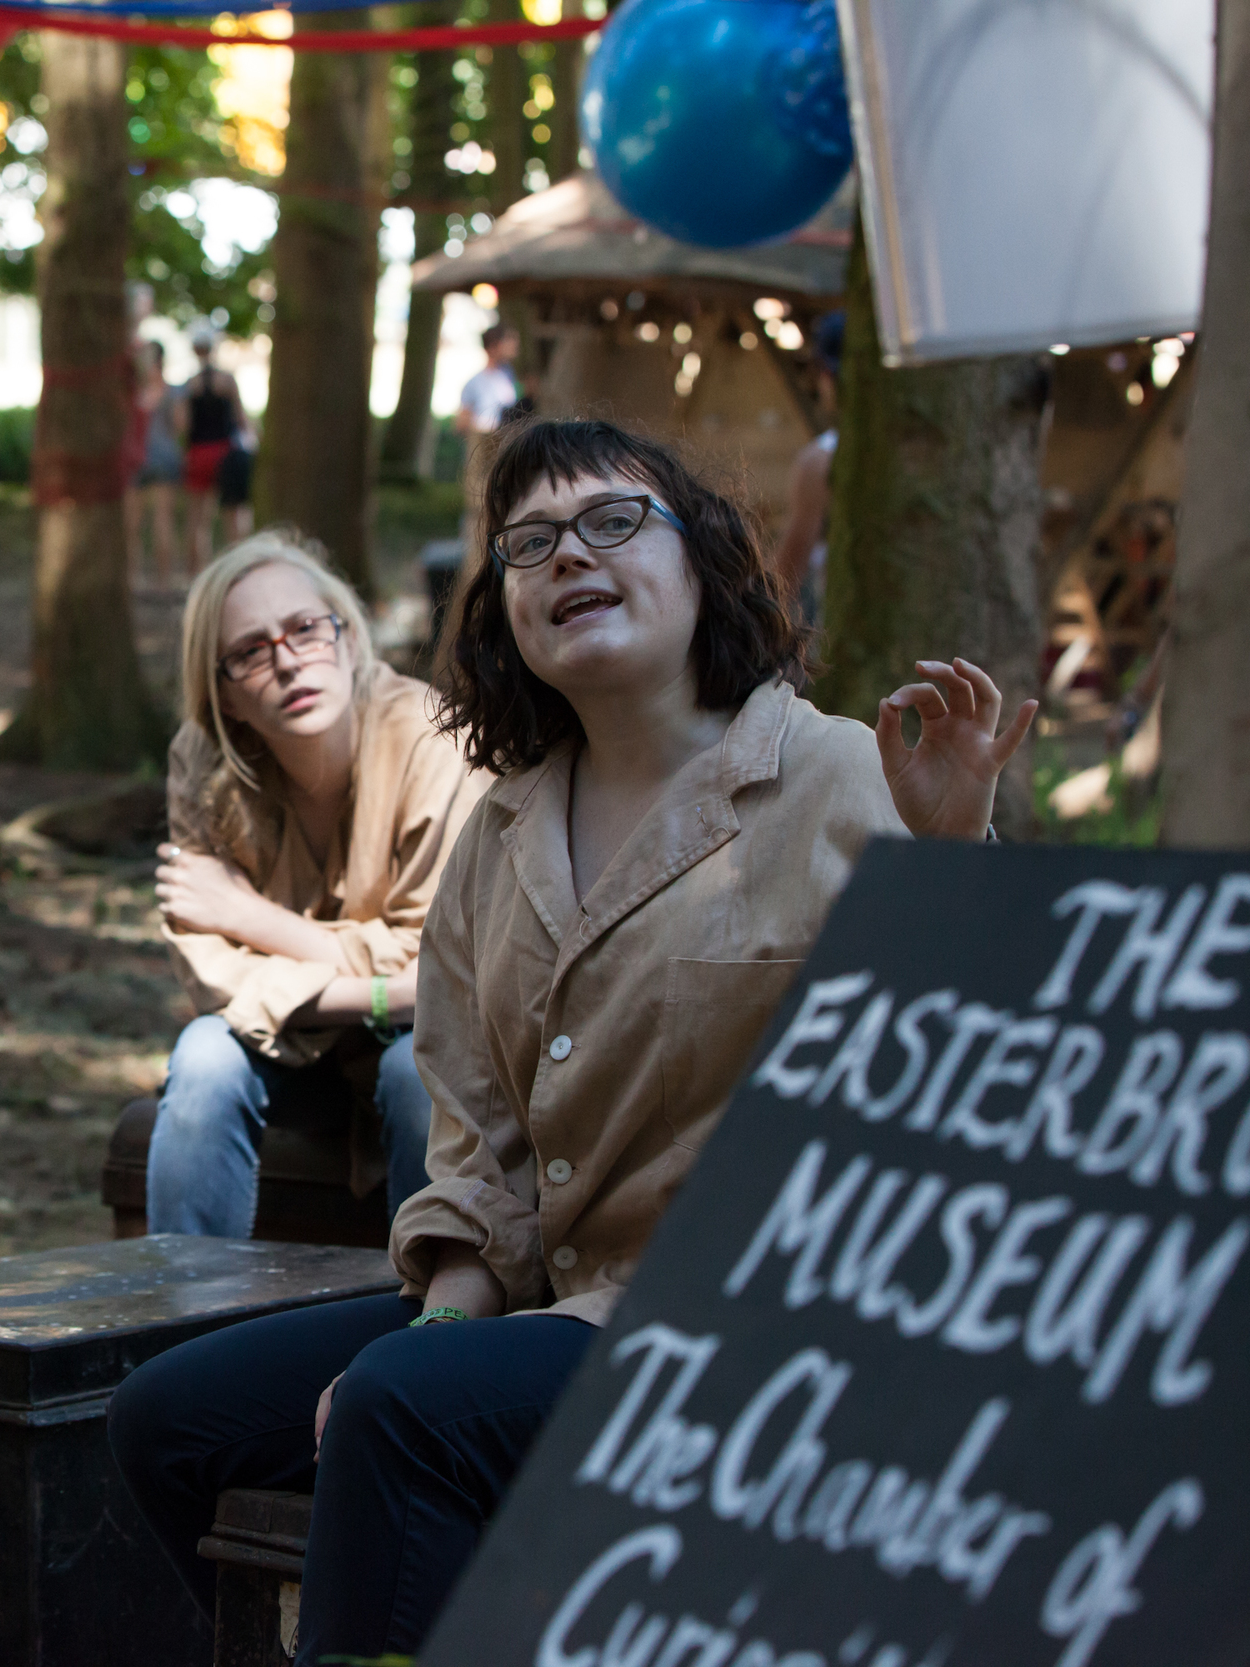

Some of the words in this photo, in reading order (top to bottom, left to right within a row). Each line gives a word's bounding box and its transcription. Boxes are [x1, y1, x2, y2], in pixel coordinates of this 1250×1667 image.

[1033, 878, 1250, 1018] THE
[723, 1141, 1250, 1406] MUSEUM
[576, 1323, 718, 1508] The
[712, 1348, 1050, 1598] Chamber
[1041, 1479, 1202, 1667] of
